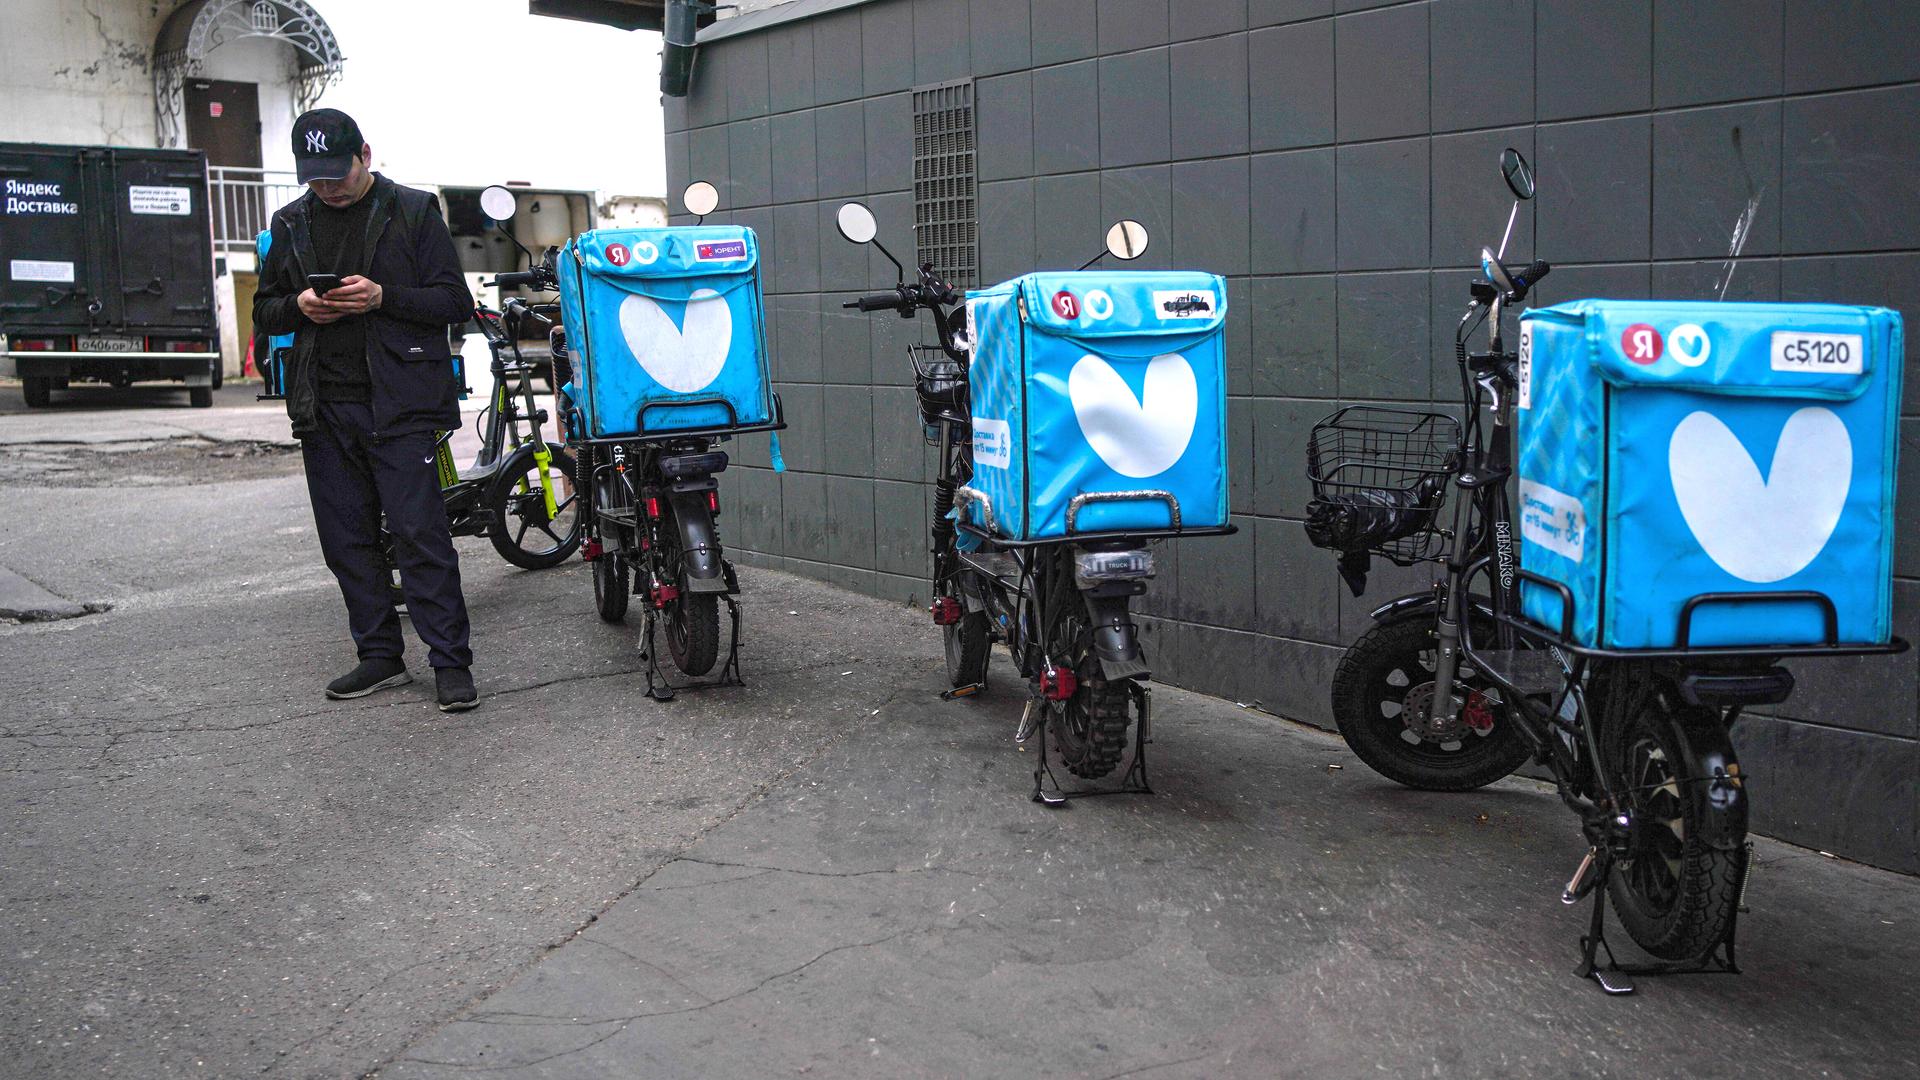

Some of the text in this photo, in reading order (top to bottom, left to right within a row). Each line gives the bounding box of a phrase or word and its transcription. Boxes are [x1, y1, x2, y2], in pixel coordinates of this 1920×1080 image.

[305, 130, 328, 153] NY
[6, 179, 61, 196] Яндекс
[6, 197, 78, 214] Доставка
[611, 247, 625, 263] Я
[714, 246, 742, 254] ЮРЕНТ
[1060, 295, 1075, 316] Я
[1632, 330, 1654, 359] Я
[1495, 521, 1514, 590] MINAKO
